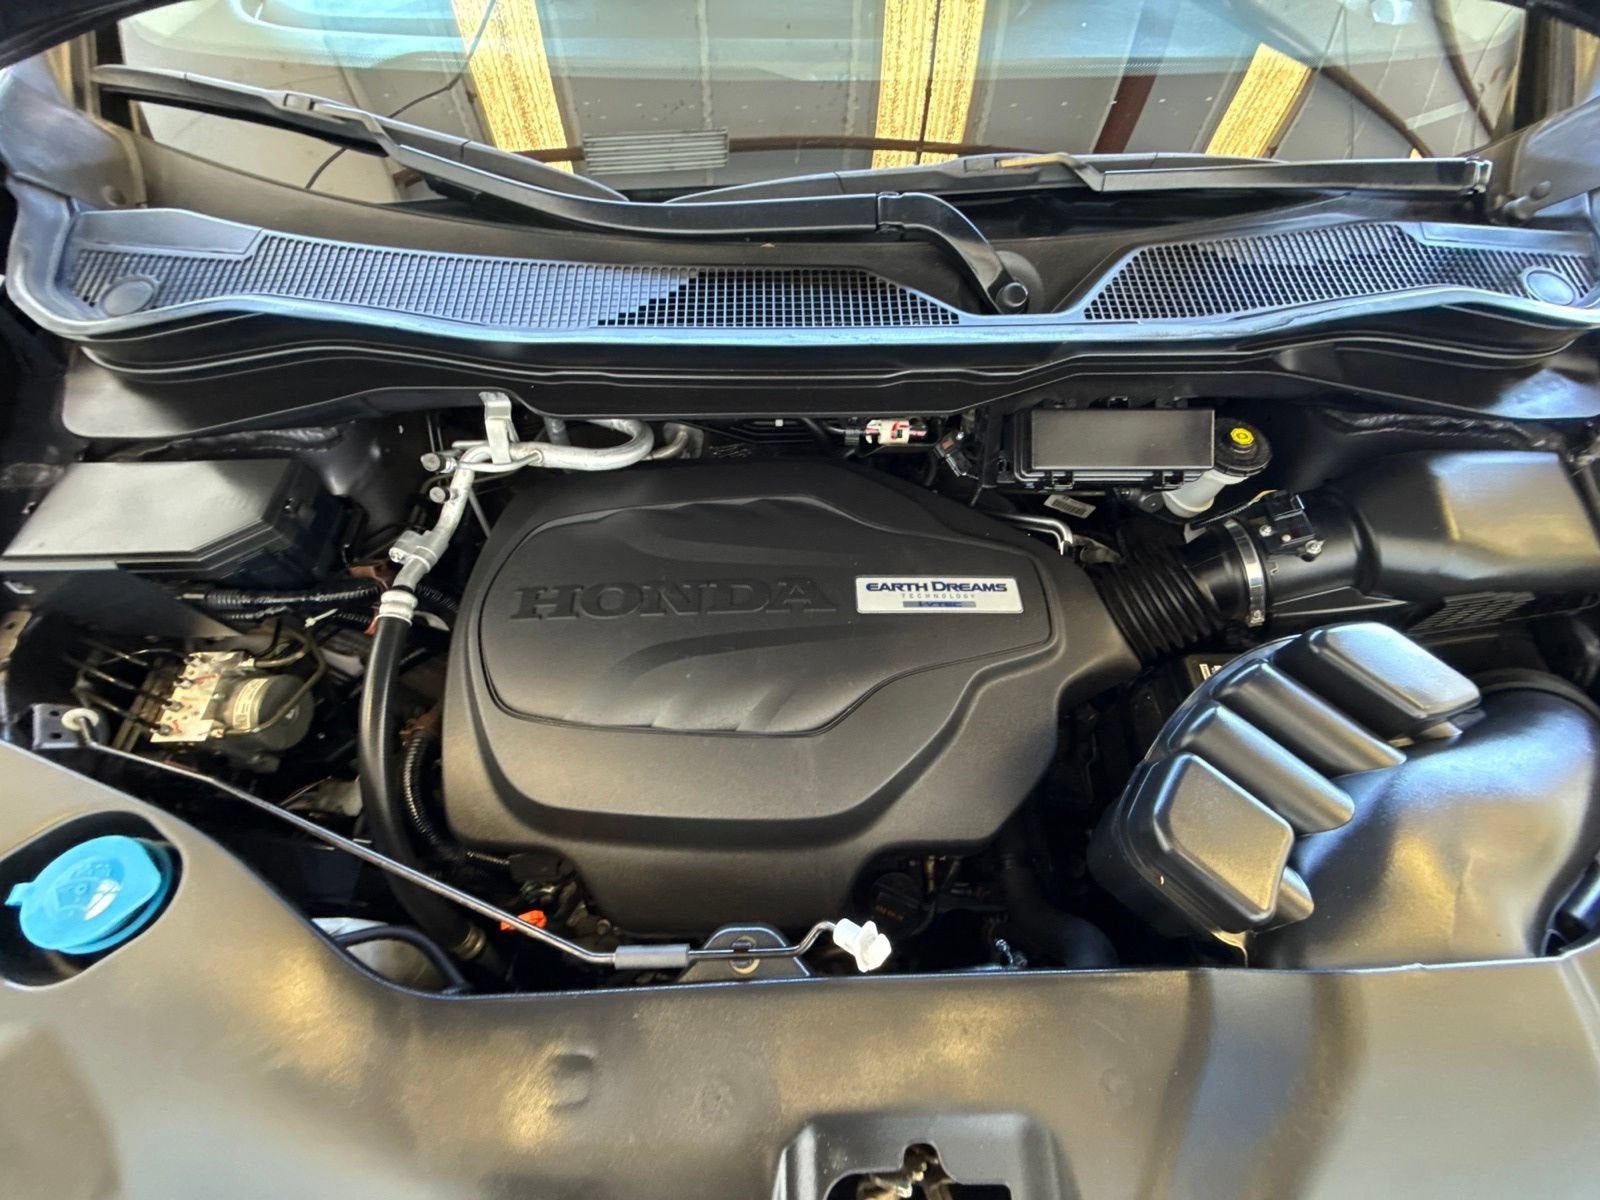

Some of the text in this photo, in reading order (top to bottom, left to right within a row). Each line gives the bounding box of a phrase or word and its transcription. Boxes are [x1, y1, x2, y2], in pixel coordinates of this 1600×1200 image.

[509, 577, 838, 620] HONDA
[865, 581, 1008, 592] EARTH DREAMS
